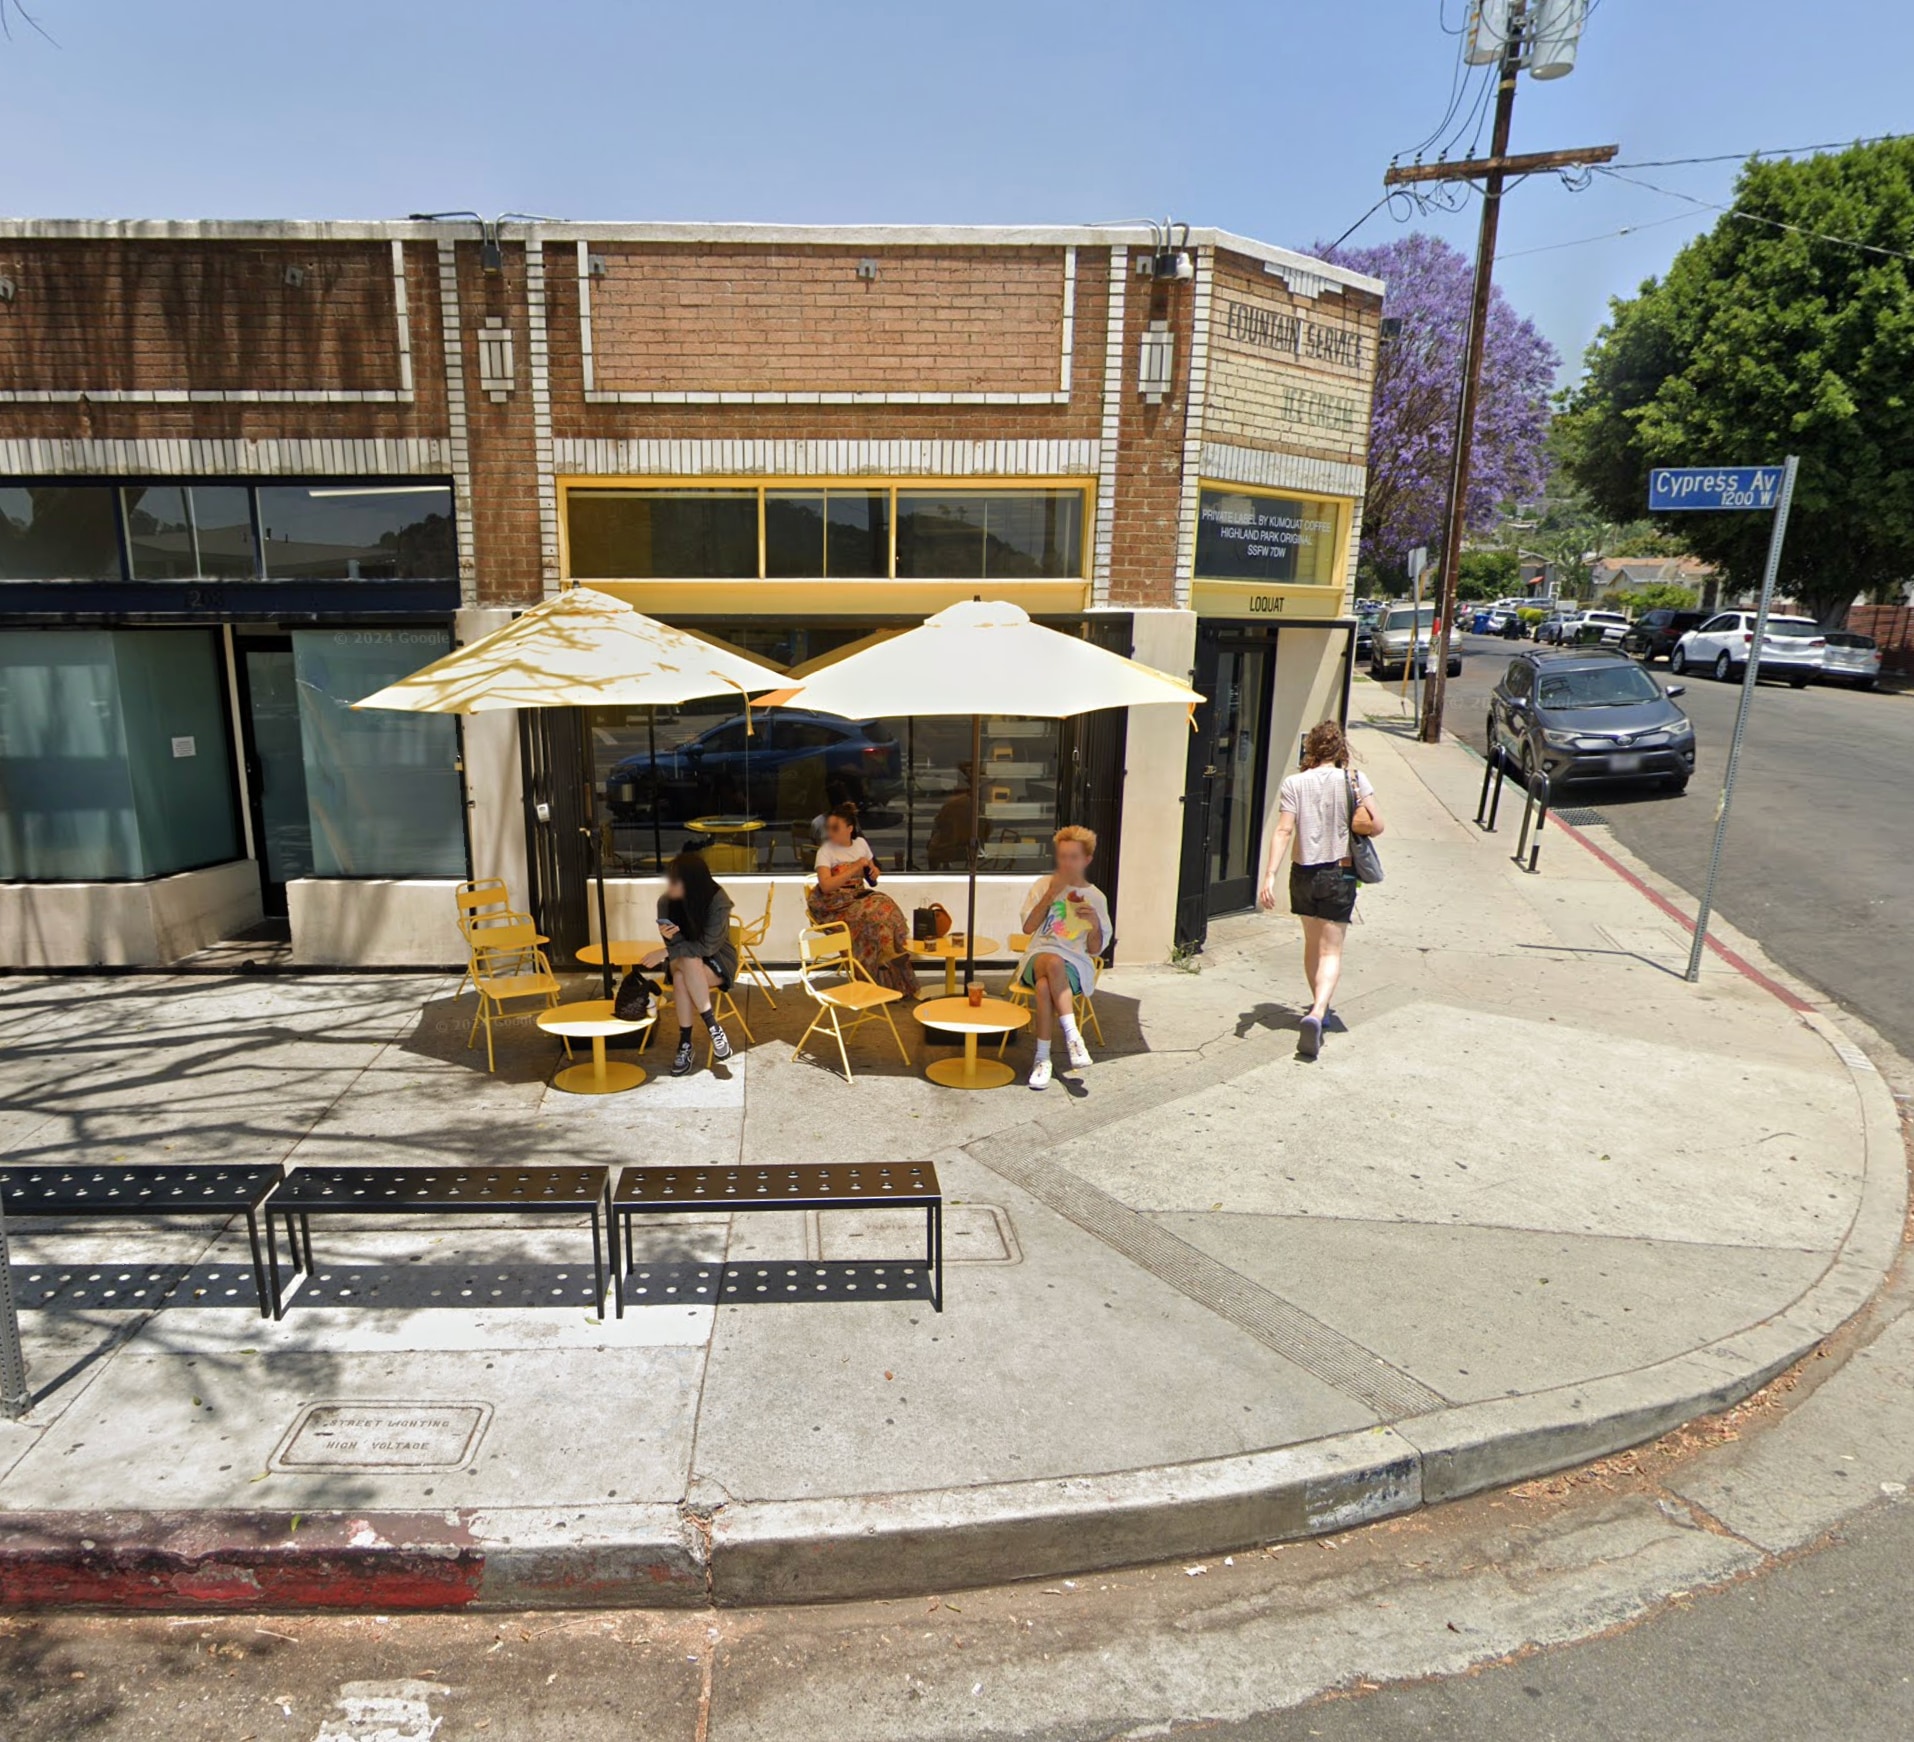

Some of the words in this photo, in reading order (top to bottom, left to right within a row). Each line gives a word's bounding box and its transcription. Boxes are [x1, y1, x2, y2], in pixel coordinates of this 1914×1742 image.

[1227, 302, 1301, 354] FOUNTAIN
[1306, 323, 1363, 368] SERVICE
[1309, 393, 1354, 429] CREAM
[1656, 471, 1739, 498] Cypress
[1750, 470, 1775, 491] Av
[1721, 491, 1754, 506] 1200
[1760, 491, 1773, 505] W
[1202, 509, 1234, 523] PRIVATE
[1234, 512, 1257, 525] LABEL
[1259, 515, 1269, 526] BY
[1269, 516, 1303, 530] KUMQUAT
[1304, 520, 1332, 533] COFFEE
[1220, 527, 1259, 541] HIGHLAND
[1260, 530, 1280, 542] PARK
[1280, 533, 1312, 546] ORIGINAL
[1247, 544, 1268, 557] SSFW
[1269, 546, 1287, 558] 7DW
[1249, 595, 1285, 613] LOQUAT
[329, 1418, 383, 1429] STREET
[387, 1418, 450, 1429] LIGHTING
[326, 1441, 358, 1451] HIGH
[372, 1441, 430, 1451] VOLTAGE
